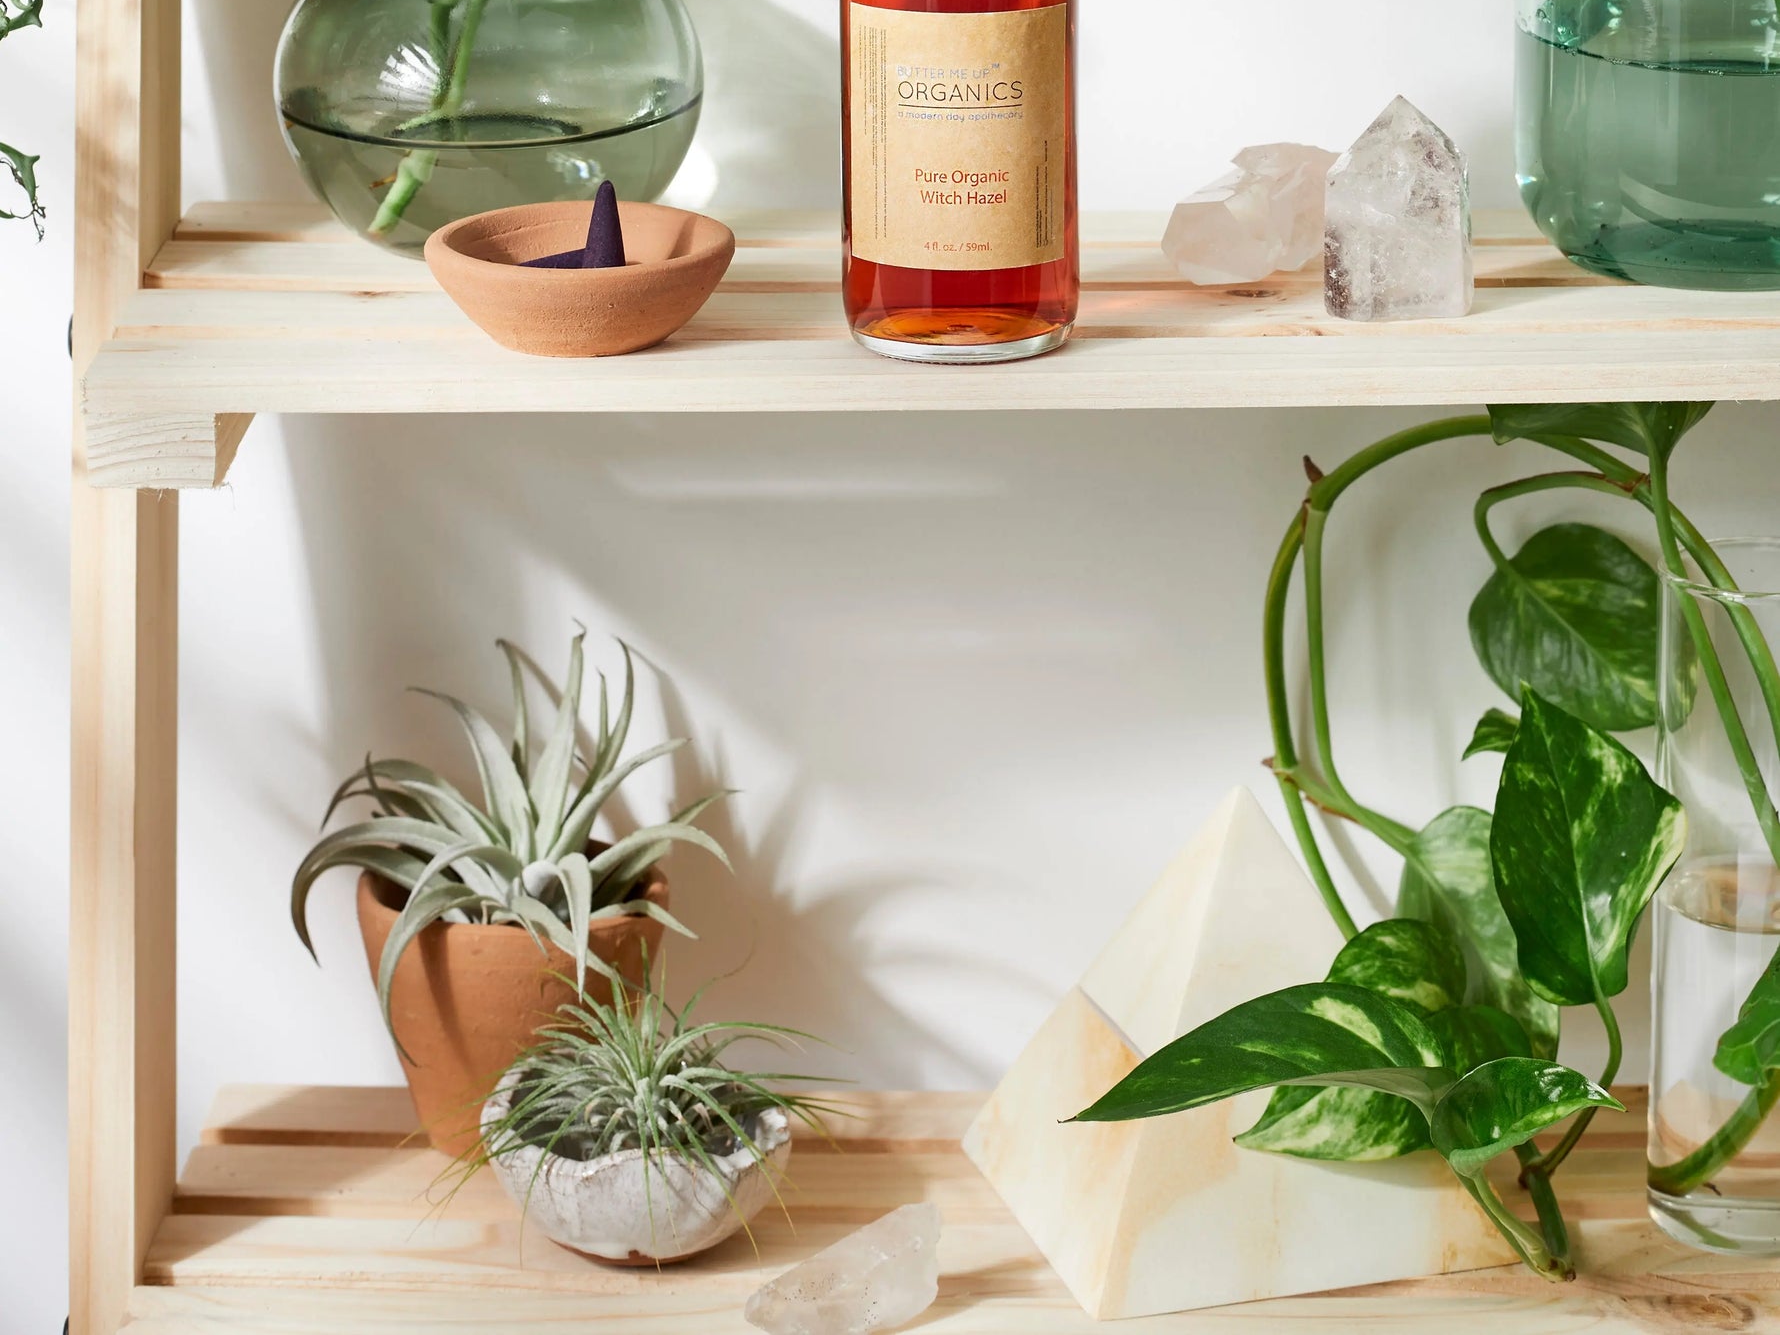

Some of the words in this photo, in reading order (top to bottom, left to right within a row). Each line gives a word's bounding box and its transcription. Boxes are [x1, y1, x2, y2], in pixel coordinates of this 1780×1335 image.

[898, 81, 1023, 102] ORGANICS
[906, 111, 943, 120] modern
[945, 113, 965, 122] day
[915, 169, 948, 183] Pure
[951, 169, 1010, 187] Organic
[920, 190, 962, 205] Witch
[967, 189, 1007, 205] Hazel
[924, 242, 930, 251] 4
[942, 244, 957, 252] oz.
[966, 242, 993, 252] 59ml.
